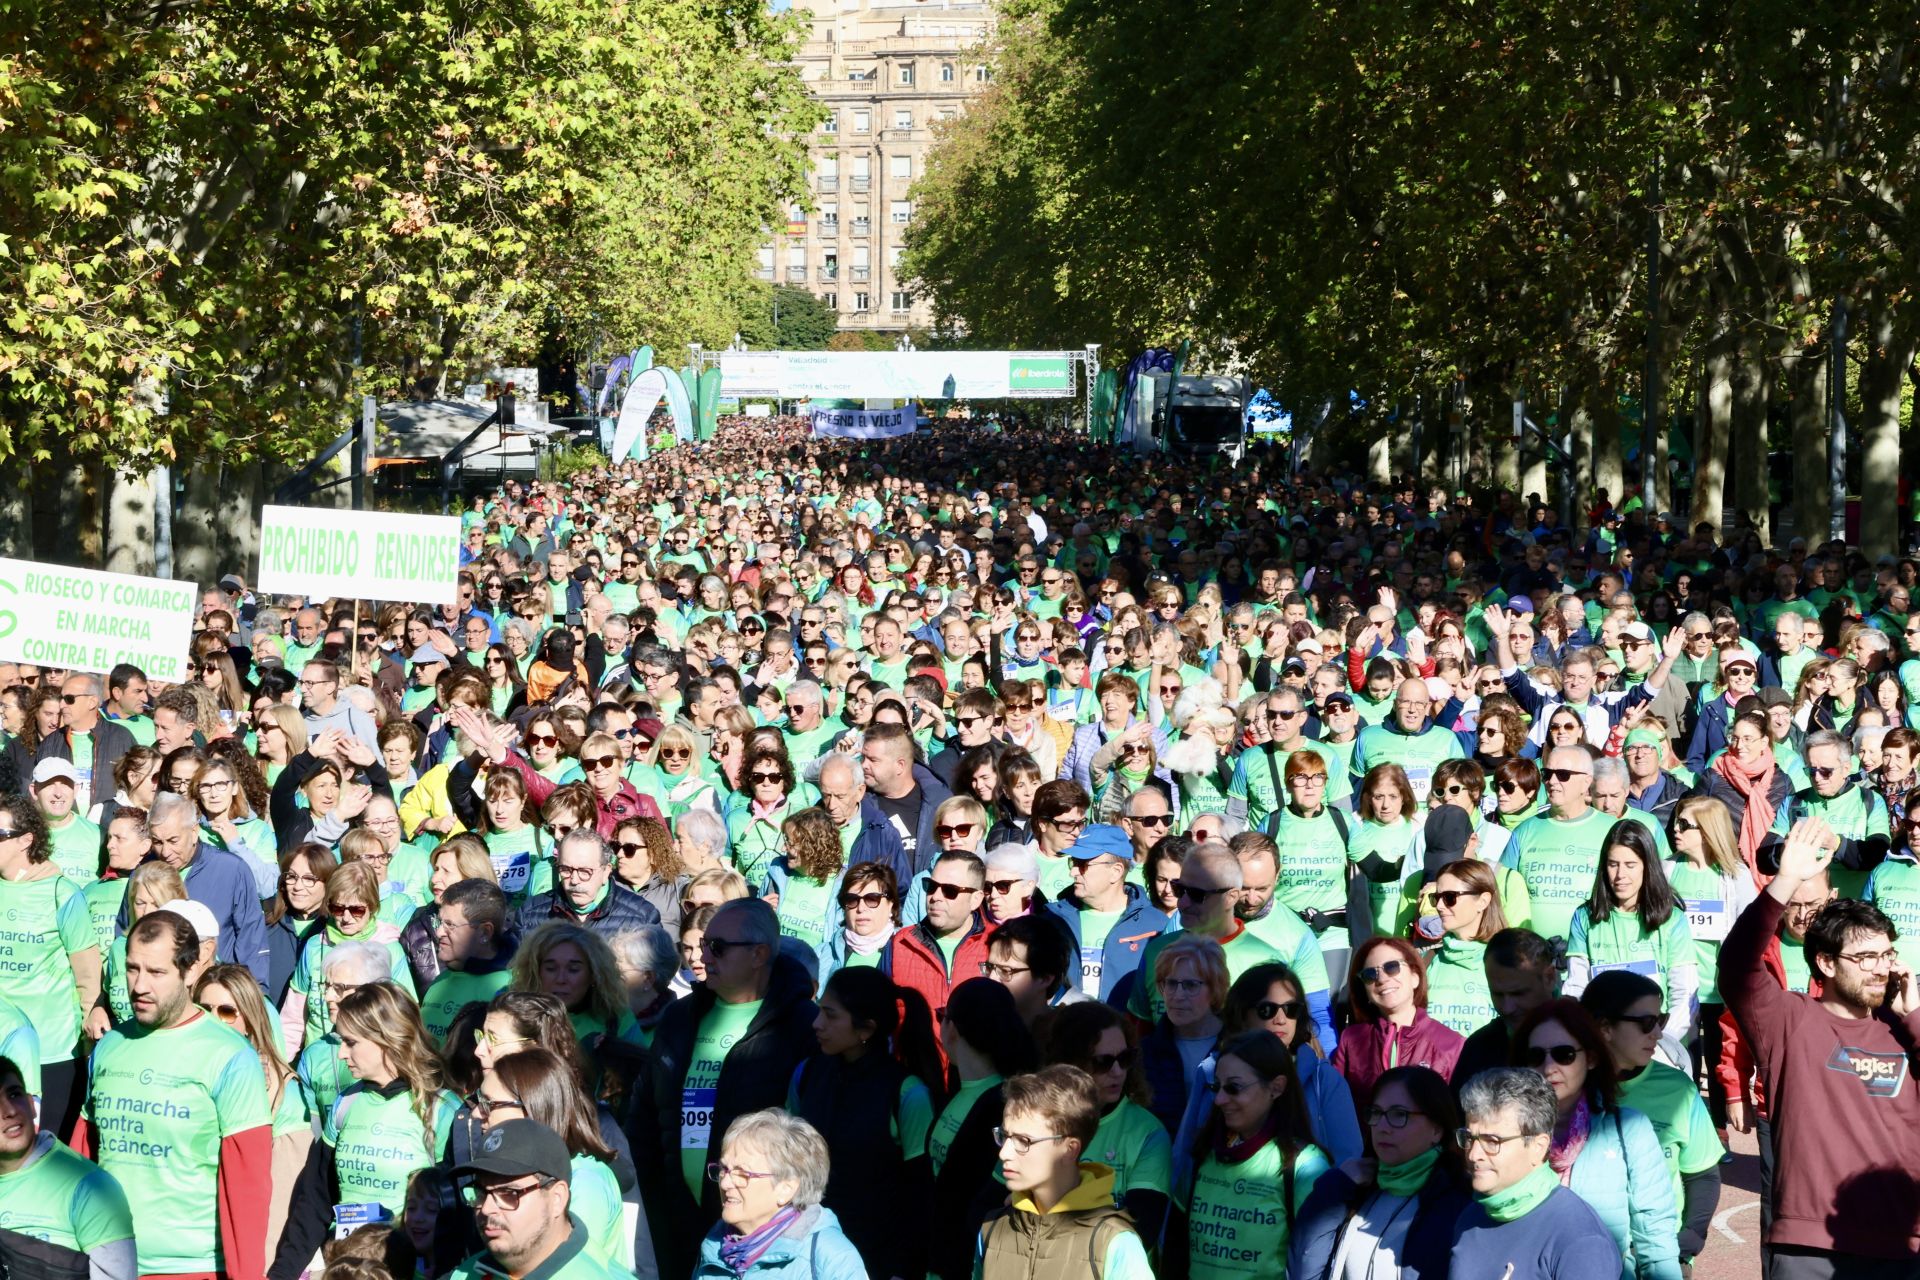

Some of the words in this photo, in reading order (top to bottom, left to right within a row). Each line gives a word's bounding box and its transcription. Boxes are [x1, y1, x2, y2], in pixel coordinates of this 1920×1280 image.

[814, 410, 854, 428] FRESNO
[858, 416, 868, 428] EL
[870, 413, 902, 428] VIEJO
[262, 525, 360, 577] PROHIBIDO
[374, 532, 457, 583] RENDIRSE
[25, 572, 94, 600] RIOSECO
[100, 582, 110, 603] Y
[113, 583, 191, 613] COMARCA
[56, 610, 78, 632] EN
[83, 614, 152, 640] MARCHA
[23, 638, 88, 666] CONTRA
[93, 648, 109, 669] EL
[1282, 855, 1296, 864] En
[1300, 856, 1342, 864] marcha
[1530, 862, 1546, 872] En
[1282, 867, 1322, 876] contra
[1528, 875, 1572, 886] contra
[1542, 887, 1590, 898] cáncer
[1884, 898, 1901, 909] En
[96, 1092, 112, 1109] En
[116, 1097, 190, 1120] marcha
[108, 1136, 172, 1158] cáncer
[352, 1144, 414, 1161] marcha
[348, 1172, 400, 1190] cáncer
[1192, 1196, 1208, 1214] En
[1212, 1203, 1277, 1225] marcha
[1202, 1240, 1262, 1262] cáncer
